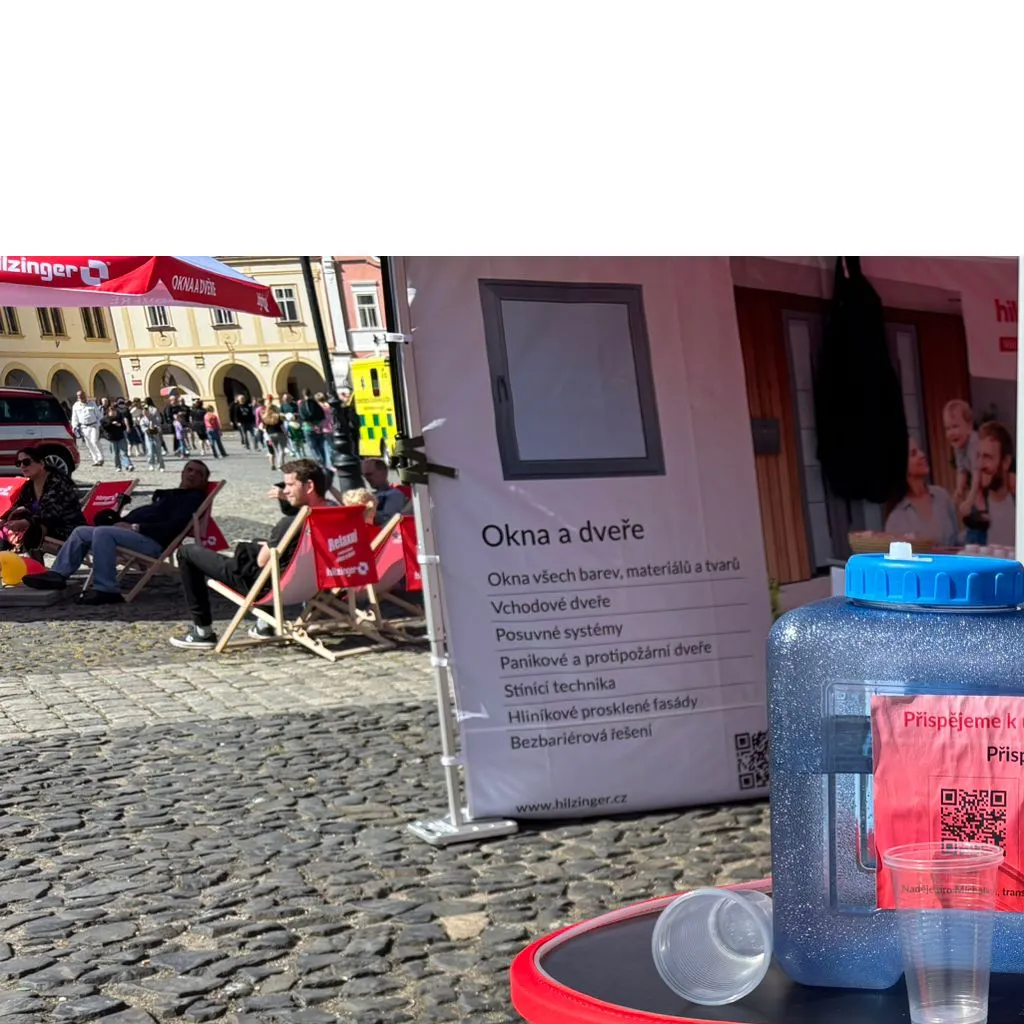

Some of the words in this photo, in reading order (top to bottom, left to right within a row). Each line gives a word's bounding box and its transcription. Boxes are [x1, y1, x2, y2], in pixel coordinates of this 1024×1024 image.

[0, 256, 78, 281] lzinger
[482, 524, 550, 547] Okna
[558, 527, 572, 544] a
[579, 518, 645, 543] dveře
[488, 571, 530, 587] Okna
[533, 568, 576, 584] všech
[579, 566, 624, 581] barev,
[626, 560, 692, 578] materiálů
[695, 562, 703, 573] a
[705, 557, 740, 572] tvarů
[491, 597, 567, 615] Vchodové
[570, 595, 611, 610] dveře
[496, 626, 561, 642] Posuvné
[564, 623, 624, 640] systémy
[500, 653, 568, 670] Panikové
[573, 655, 581, 666] a
[586, 643, 671, 667] protipožární
[674, 641, 712, 657] dveře
[504, 681, 550, 698] Stínící
[553, 677, 616, 694] technika
[508, 706, 579, 724] Hliníkové
[582, 701, 651, 721] prosklené
[653, 695, 699, 712] fasády
[904, 711, 1001, 731] Přispějeme
[1007, 713, 1017, 729] k
[510, 729, 608, 750] Bezbariérová
[611, 724, 653, 741] řešení
[516, 793, 628, 814] www.hilzinger.cz
